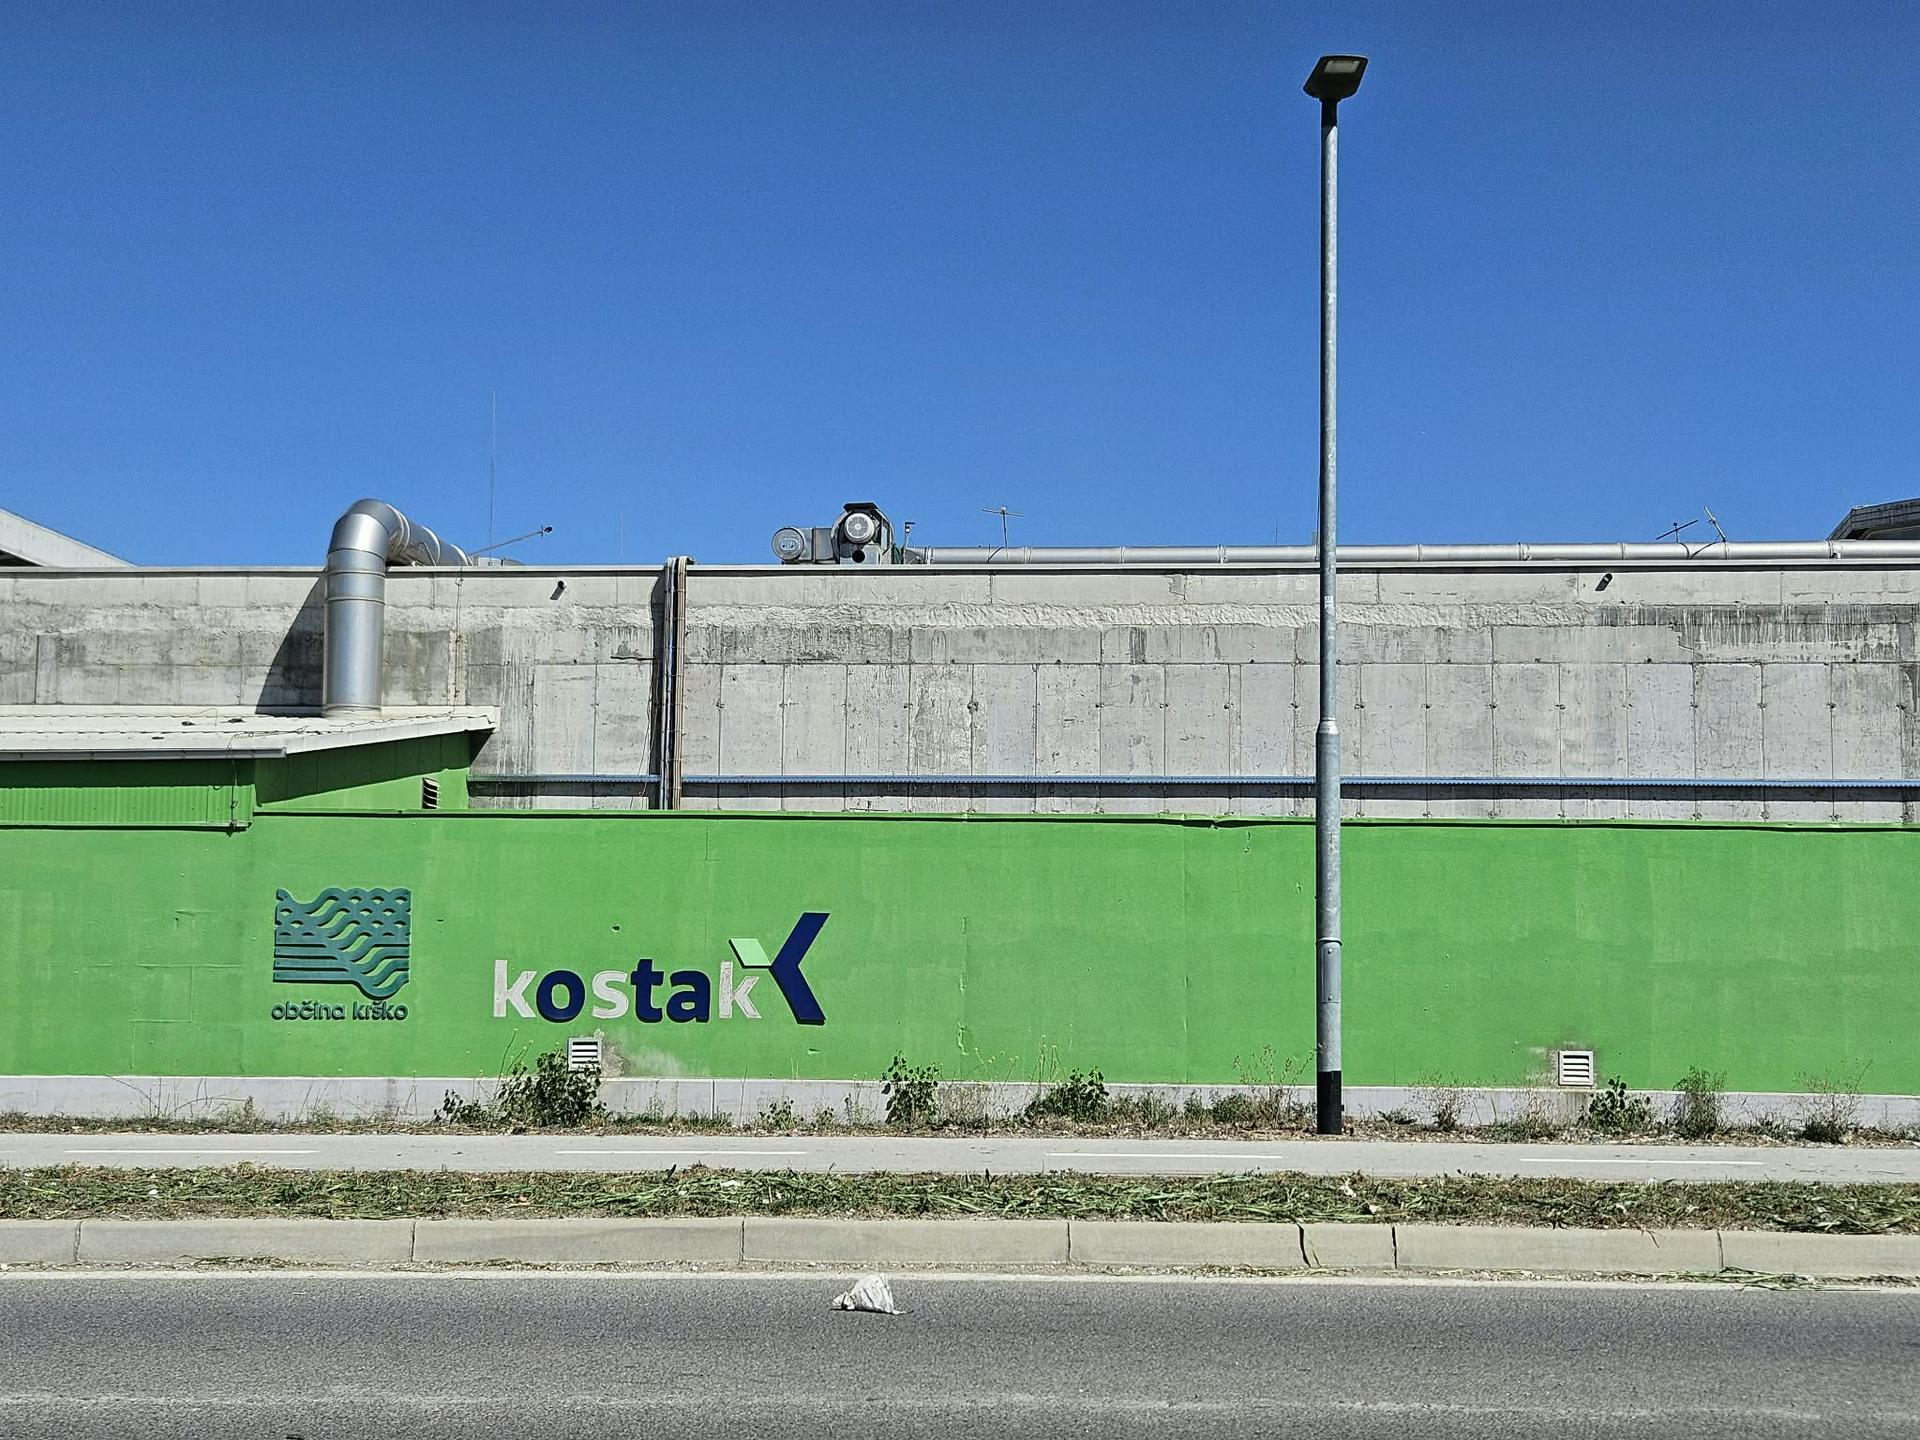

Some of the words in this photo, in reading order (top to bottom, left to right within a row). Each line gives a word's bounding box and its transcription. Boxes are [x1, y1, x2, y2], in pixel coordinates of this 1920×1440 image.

[271, 1000, 346, 1021] občina
[352, 1000, 409, 1021] krško
[493, 958, 763, 1024] kostak
